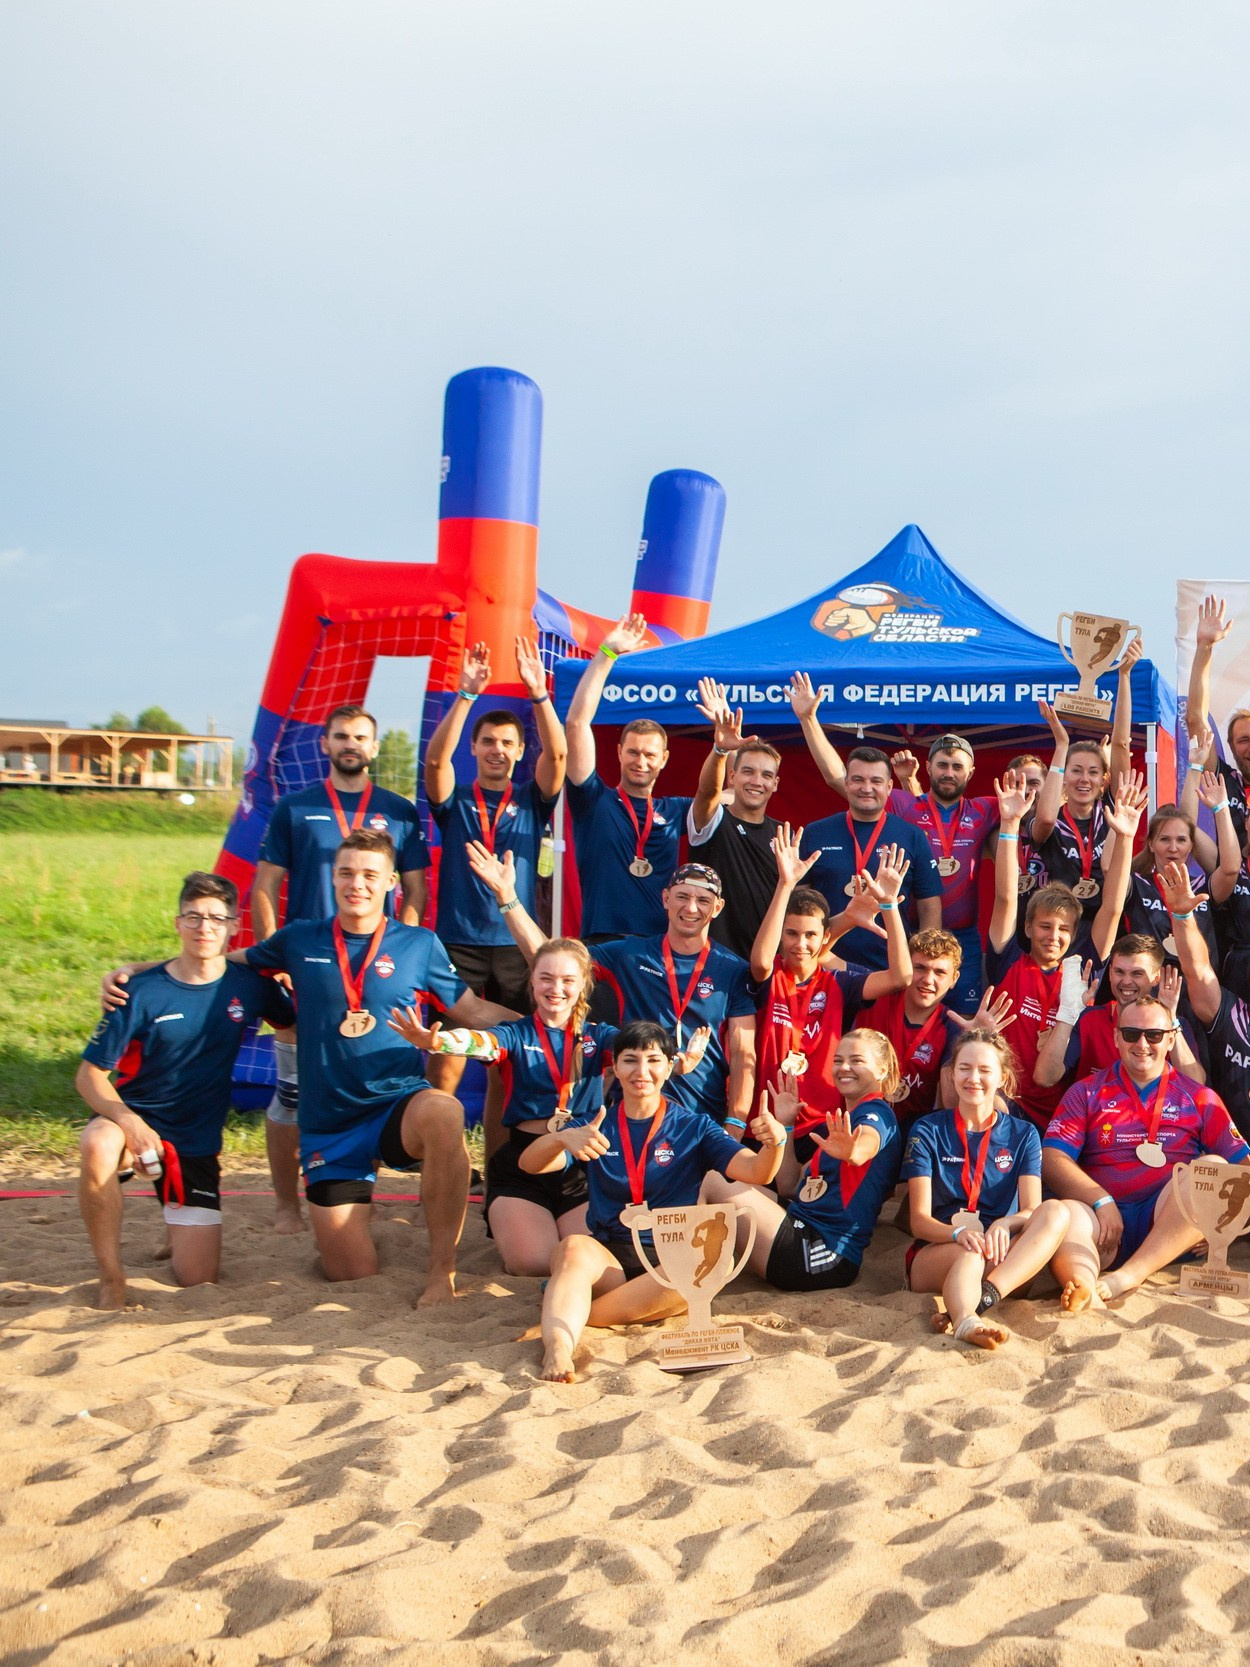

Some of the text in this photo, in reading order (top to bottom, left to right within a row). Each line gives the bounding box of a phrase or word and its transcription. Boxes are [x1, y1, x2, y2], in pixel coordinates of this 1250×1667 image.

[880, 618, 939, 627] РЕГБИ
[1075, 615, 1096, 625] РЕГБИ
[878, 626, 978, 637] ТУЛЬСКОЙ
[1075, 627, 1091, 637] ТУЛА
[873, 634, 965, 643] ОБЛАСТИ
[602, 684, 677, 703] ФСОО
[843, 684, 1005, 706] ФЕДЕРАЦИЯ
[1075, 705, 1101, 715] PARENTS
[1077, 886, 1086, 896] 2
[697, 981, 714, 991] ЦСКА
[654, 1149, 675, 1157] ЦСКА
[995, 1155, 1013, 1163] ЦСКА
[1194, 1165, 1219, 1177] РЕГБИ
[1195, 1181, 1215, 1192] ТУЛА
[657, 1213, 687, 1226] РЕГБИ
[660, 1231, 685, 1243] ТУЛА
[665, 1342, 740, 1356] Менеджмент РК ЦСКА
